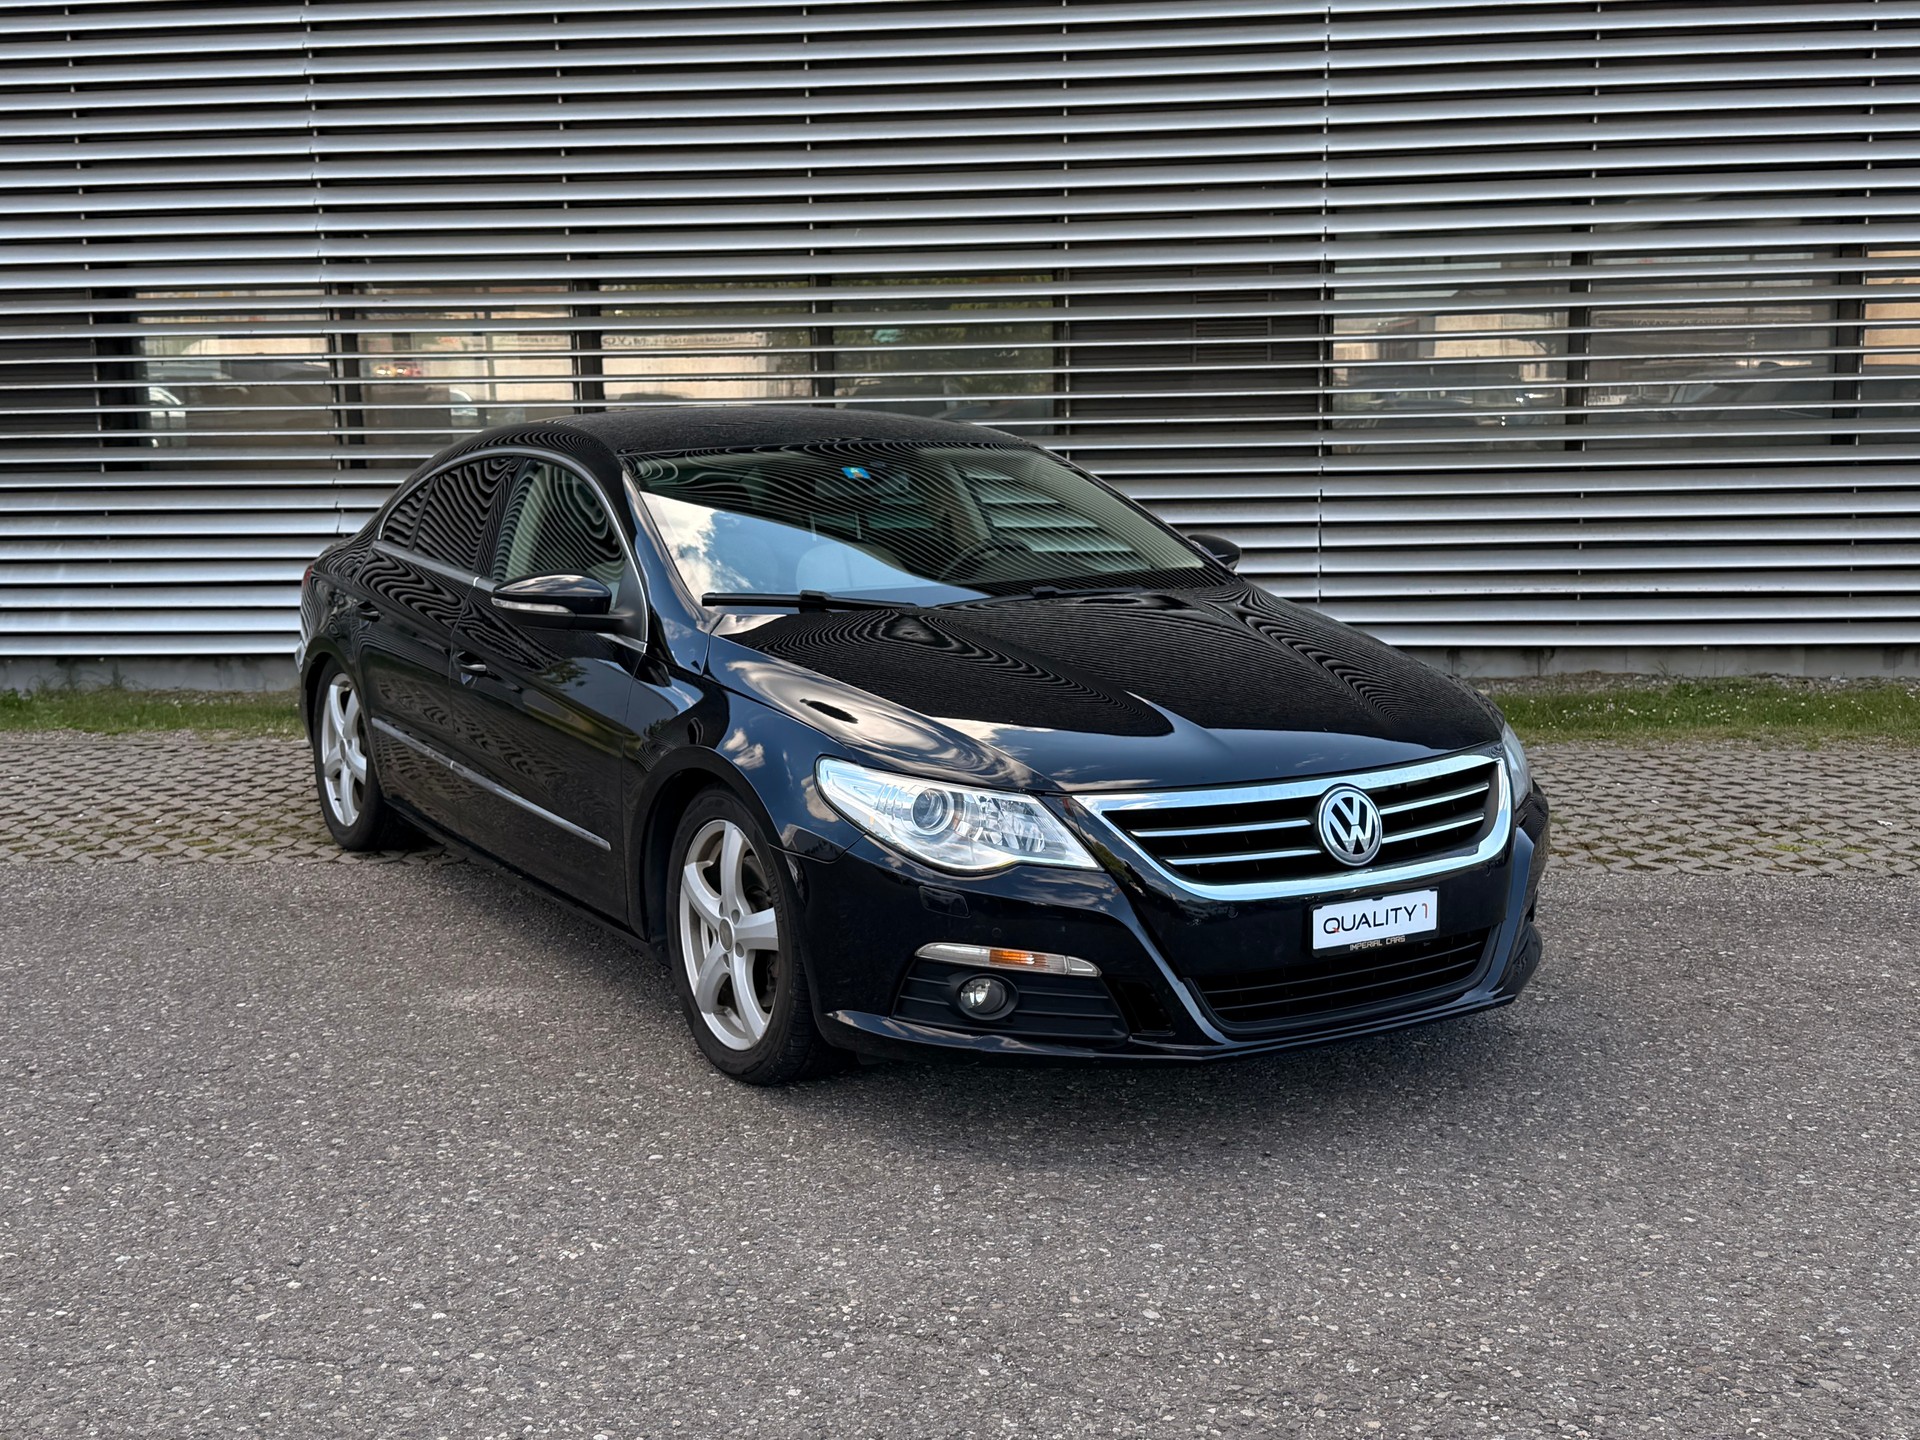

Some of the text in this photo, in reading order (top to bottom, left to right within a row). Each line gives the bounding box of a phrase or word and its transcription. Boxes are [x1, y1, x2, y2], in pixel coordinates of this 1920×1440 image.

[1322, 789, 1378, 861] VW
[1323, 902, 1429, 935] QUALITY 1
[1349, 935, 1406, 951] IMPERIAL CARS
